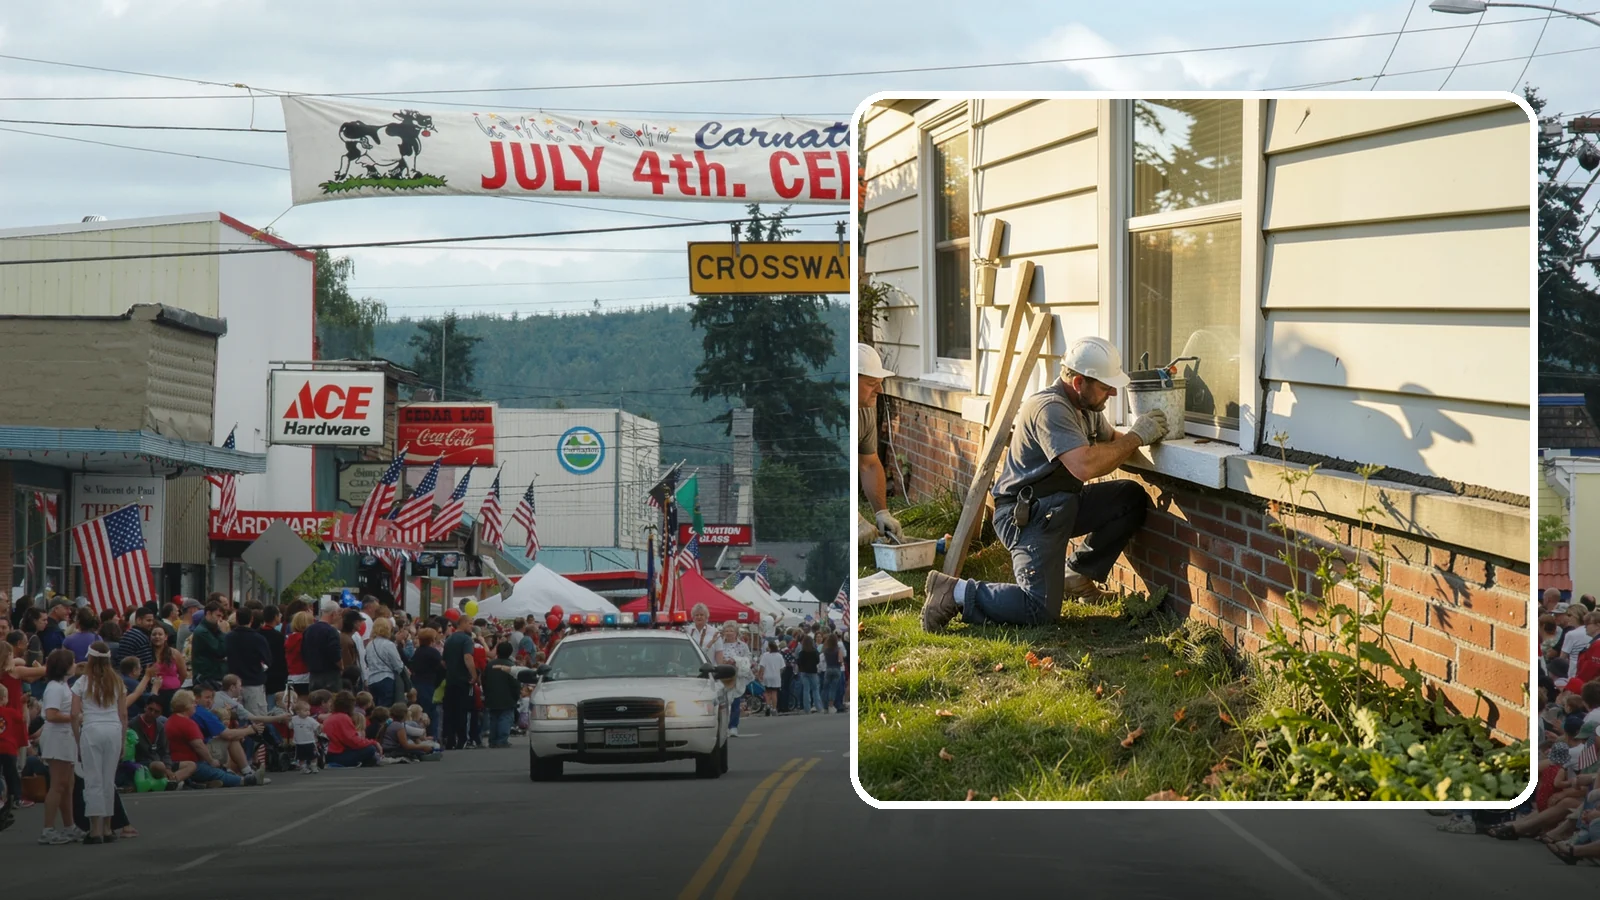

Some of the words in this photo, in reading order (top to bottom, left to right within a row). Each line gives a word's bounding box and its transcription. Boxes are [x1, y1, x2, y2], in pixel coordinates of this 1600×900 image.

[481, 141, 605, 192] JULY
[632, 150, 746, 198] 4th.
[697, 254, 850, 280] CROSSWA
[283, 380, 373, 420] ACE
[405, 409, 452, 422] CEDAR
[461, 409, 485, 422] LOG
[283, 421, 371, 436] Hardware
[95, 485, 124, 495] Vincent
[126, 486, 135, 495] de
[137, 485, 155, 495] Paul
[212, 516, 330, 535] HARDARE
[688, 526, 741, 535] CRNATION
